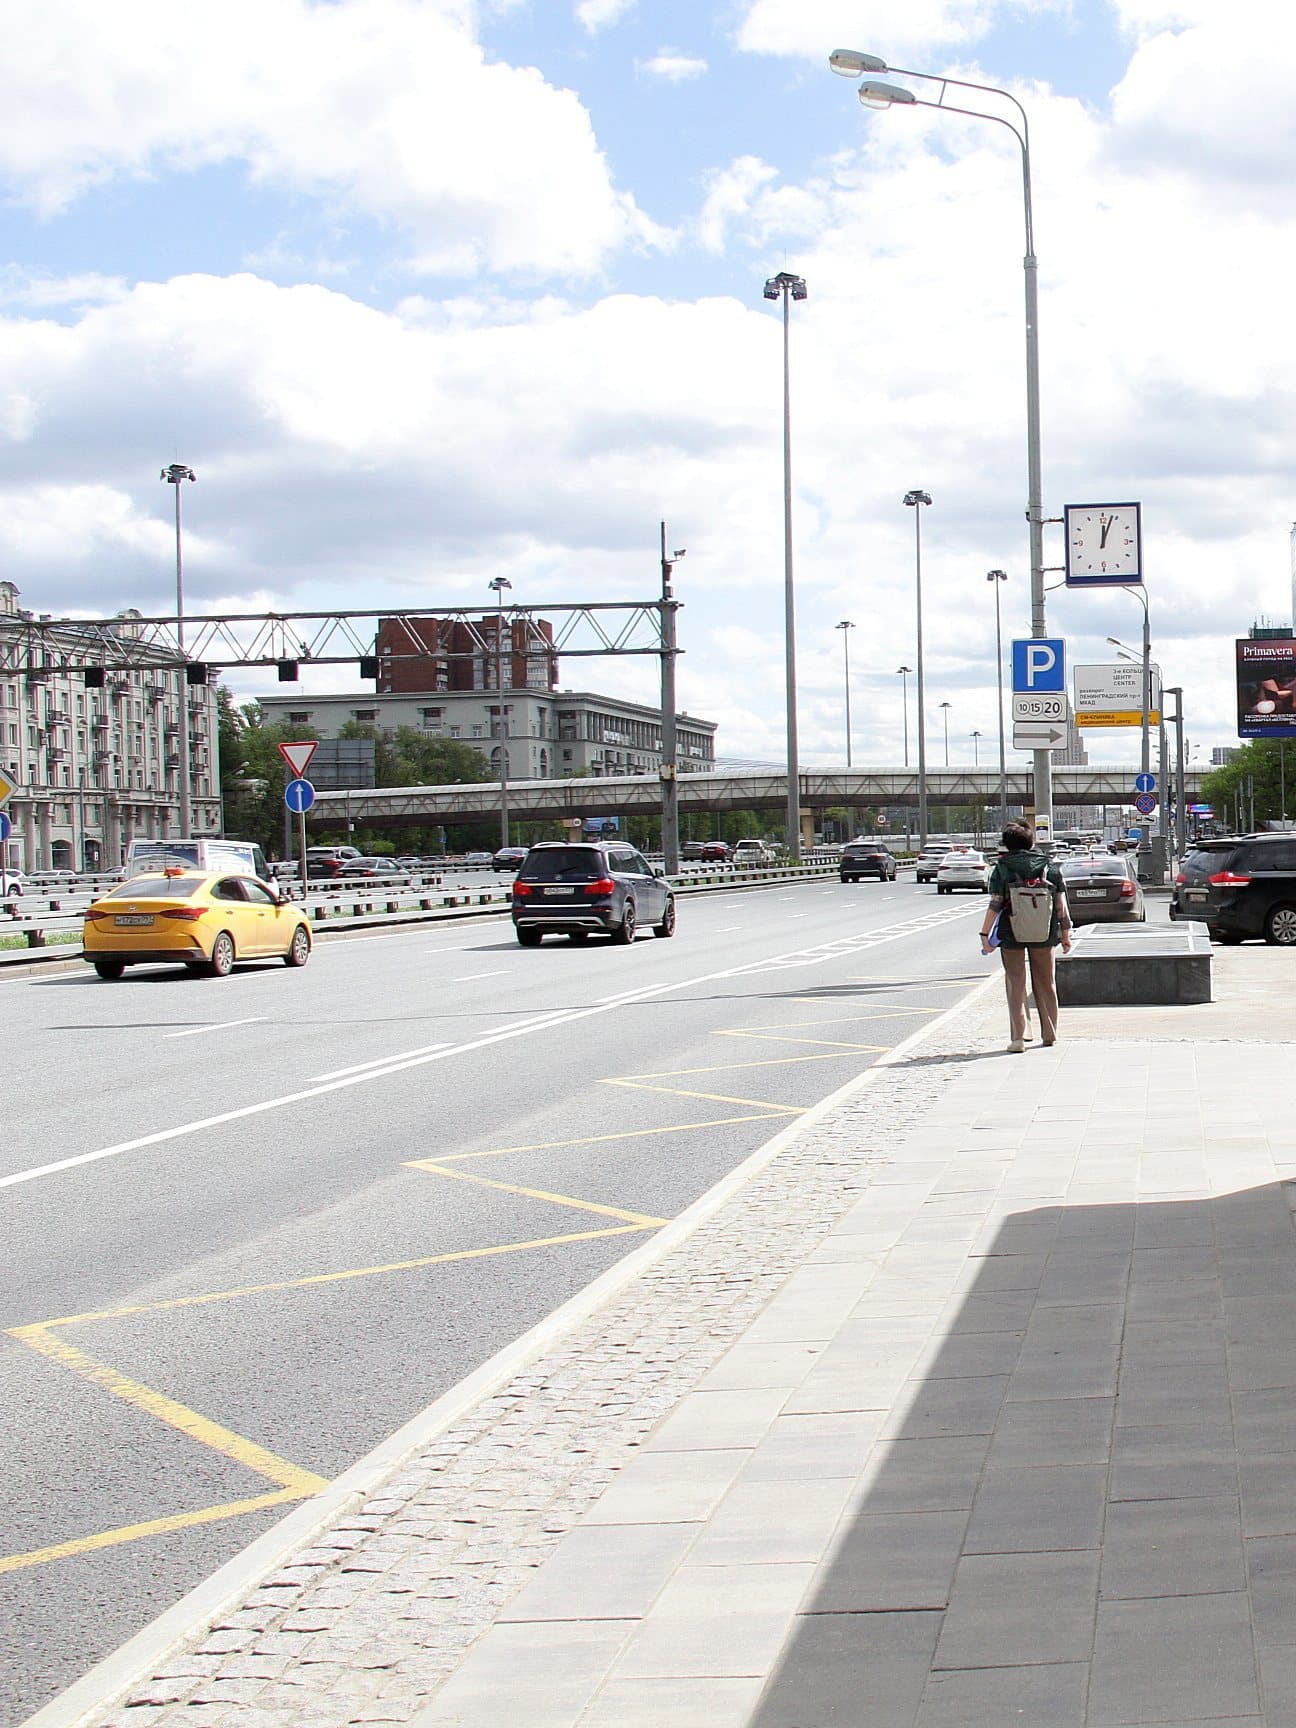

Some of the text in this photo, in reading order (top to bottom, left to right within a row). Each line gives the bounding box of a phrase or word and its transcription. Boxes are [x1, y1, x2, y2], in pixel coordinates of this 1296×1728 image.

[1243, 646, 1293, 657] Primavera
[1027, 645, 1056, 687] P
[1019, 702, 1060, 713] 10 15 20
